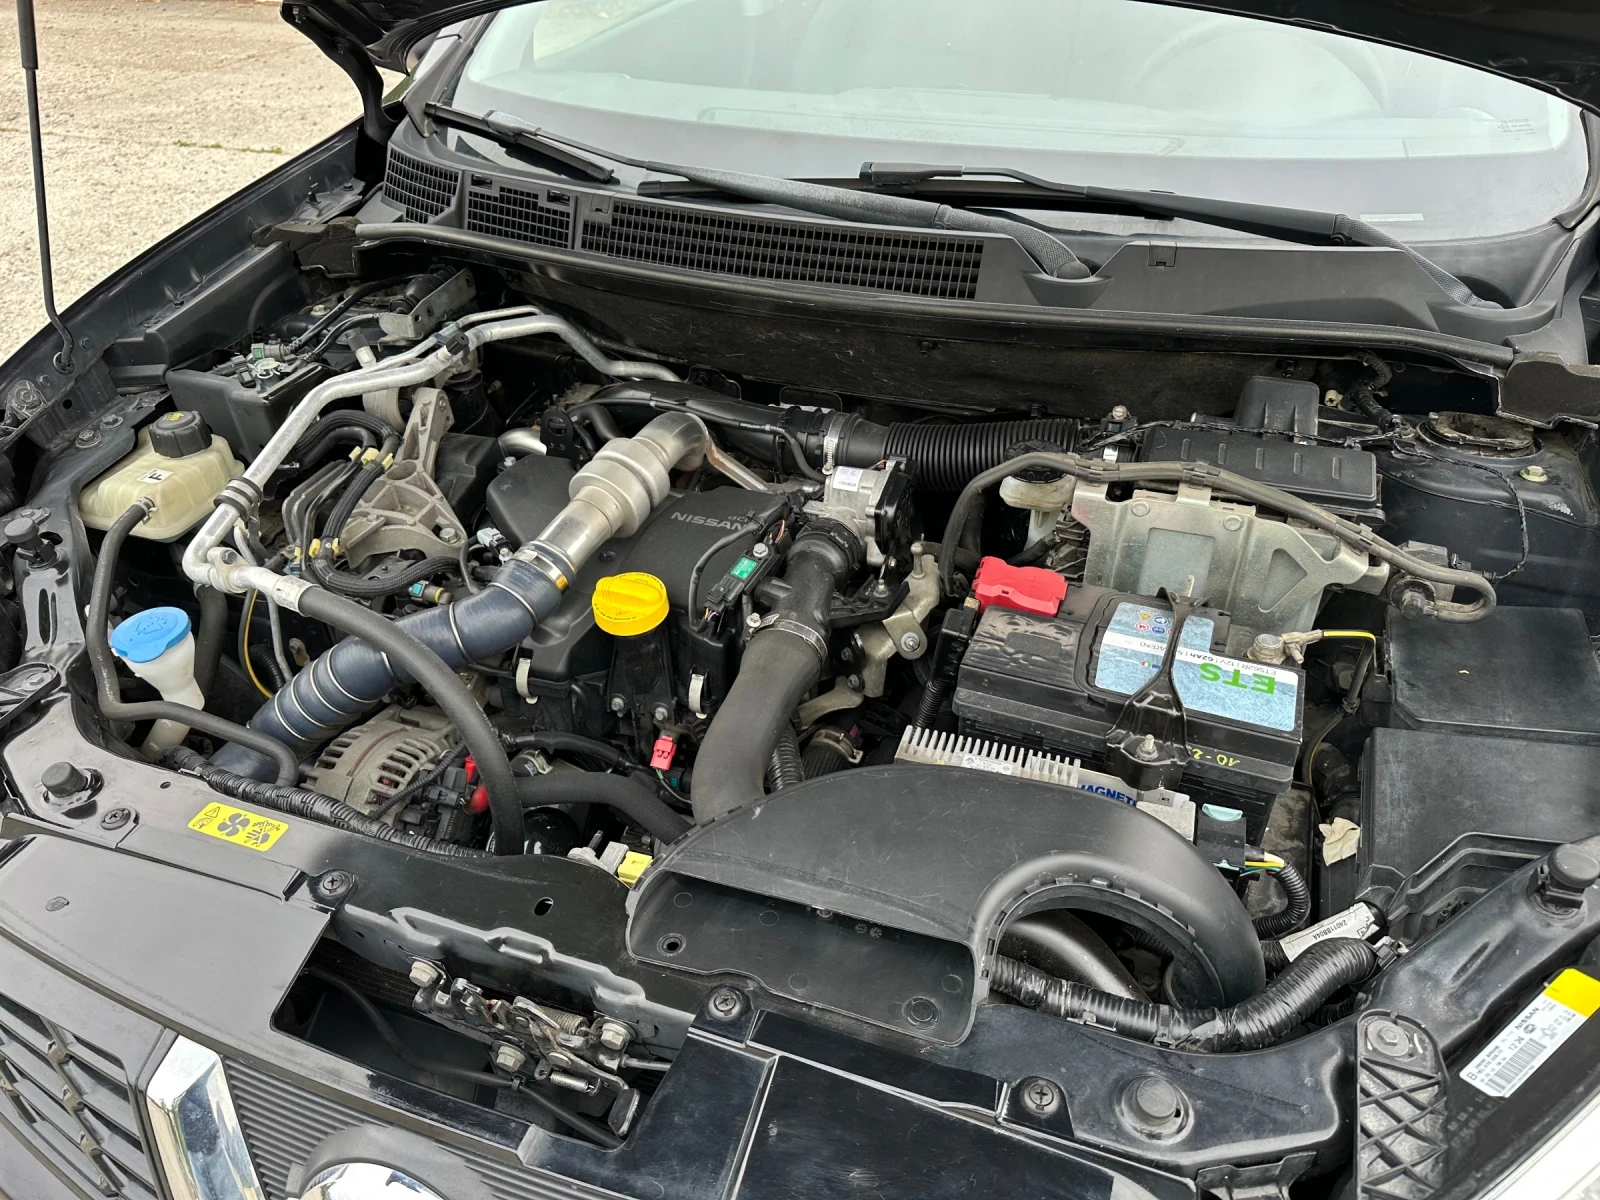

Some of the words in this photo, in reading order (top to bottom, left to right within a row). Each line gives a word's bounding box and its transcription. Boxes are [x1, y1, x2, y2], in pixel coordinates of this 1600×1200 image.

[671, 512, 747, 531] NISSAN
[1189, 652, 1213, 662] 62Ah
[1199, 662, 1276, 695] ETS
[1079, 784, 1137, 807] AGNETI
[1515, 1007, 1540, 1029] NISSAN
[1466, 1071, 1478, 1081] B
